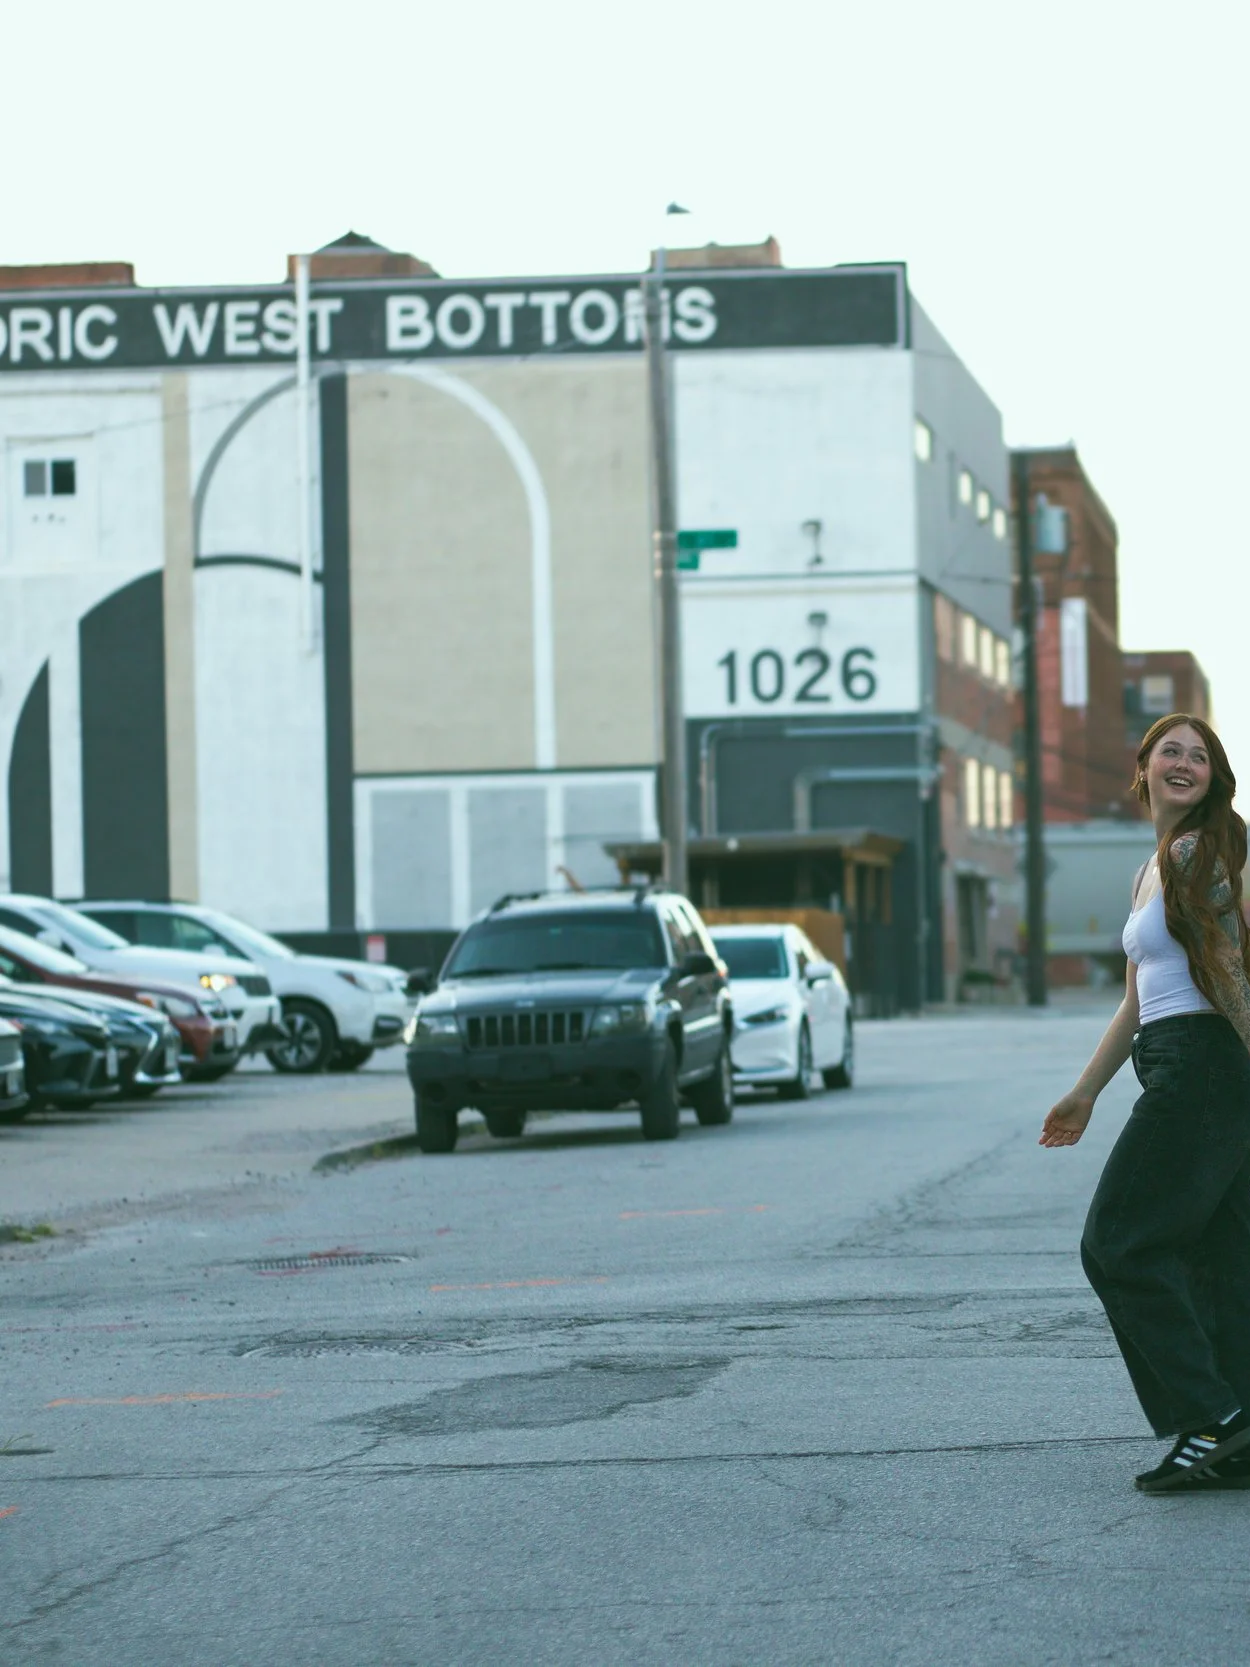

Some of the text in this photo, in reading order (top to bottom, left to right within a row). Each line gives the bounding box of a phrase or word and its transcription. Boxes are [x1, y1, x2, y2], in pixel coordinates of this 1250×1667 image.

[0, 304, 118, 363] RIC
[153, 298, 344, 357] WEST
[717, 648, 877, 704] 1026
